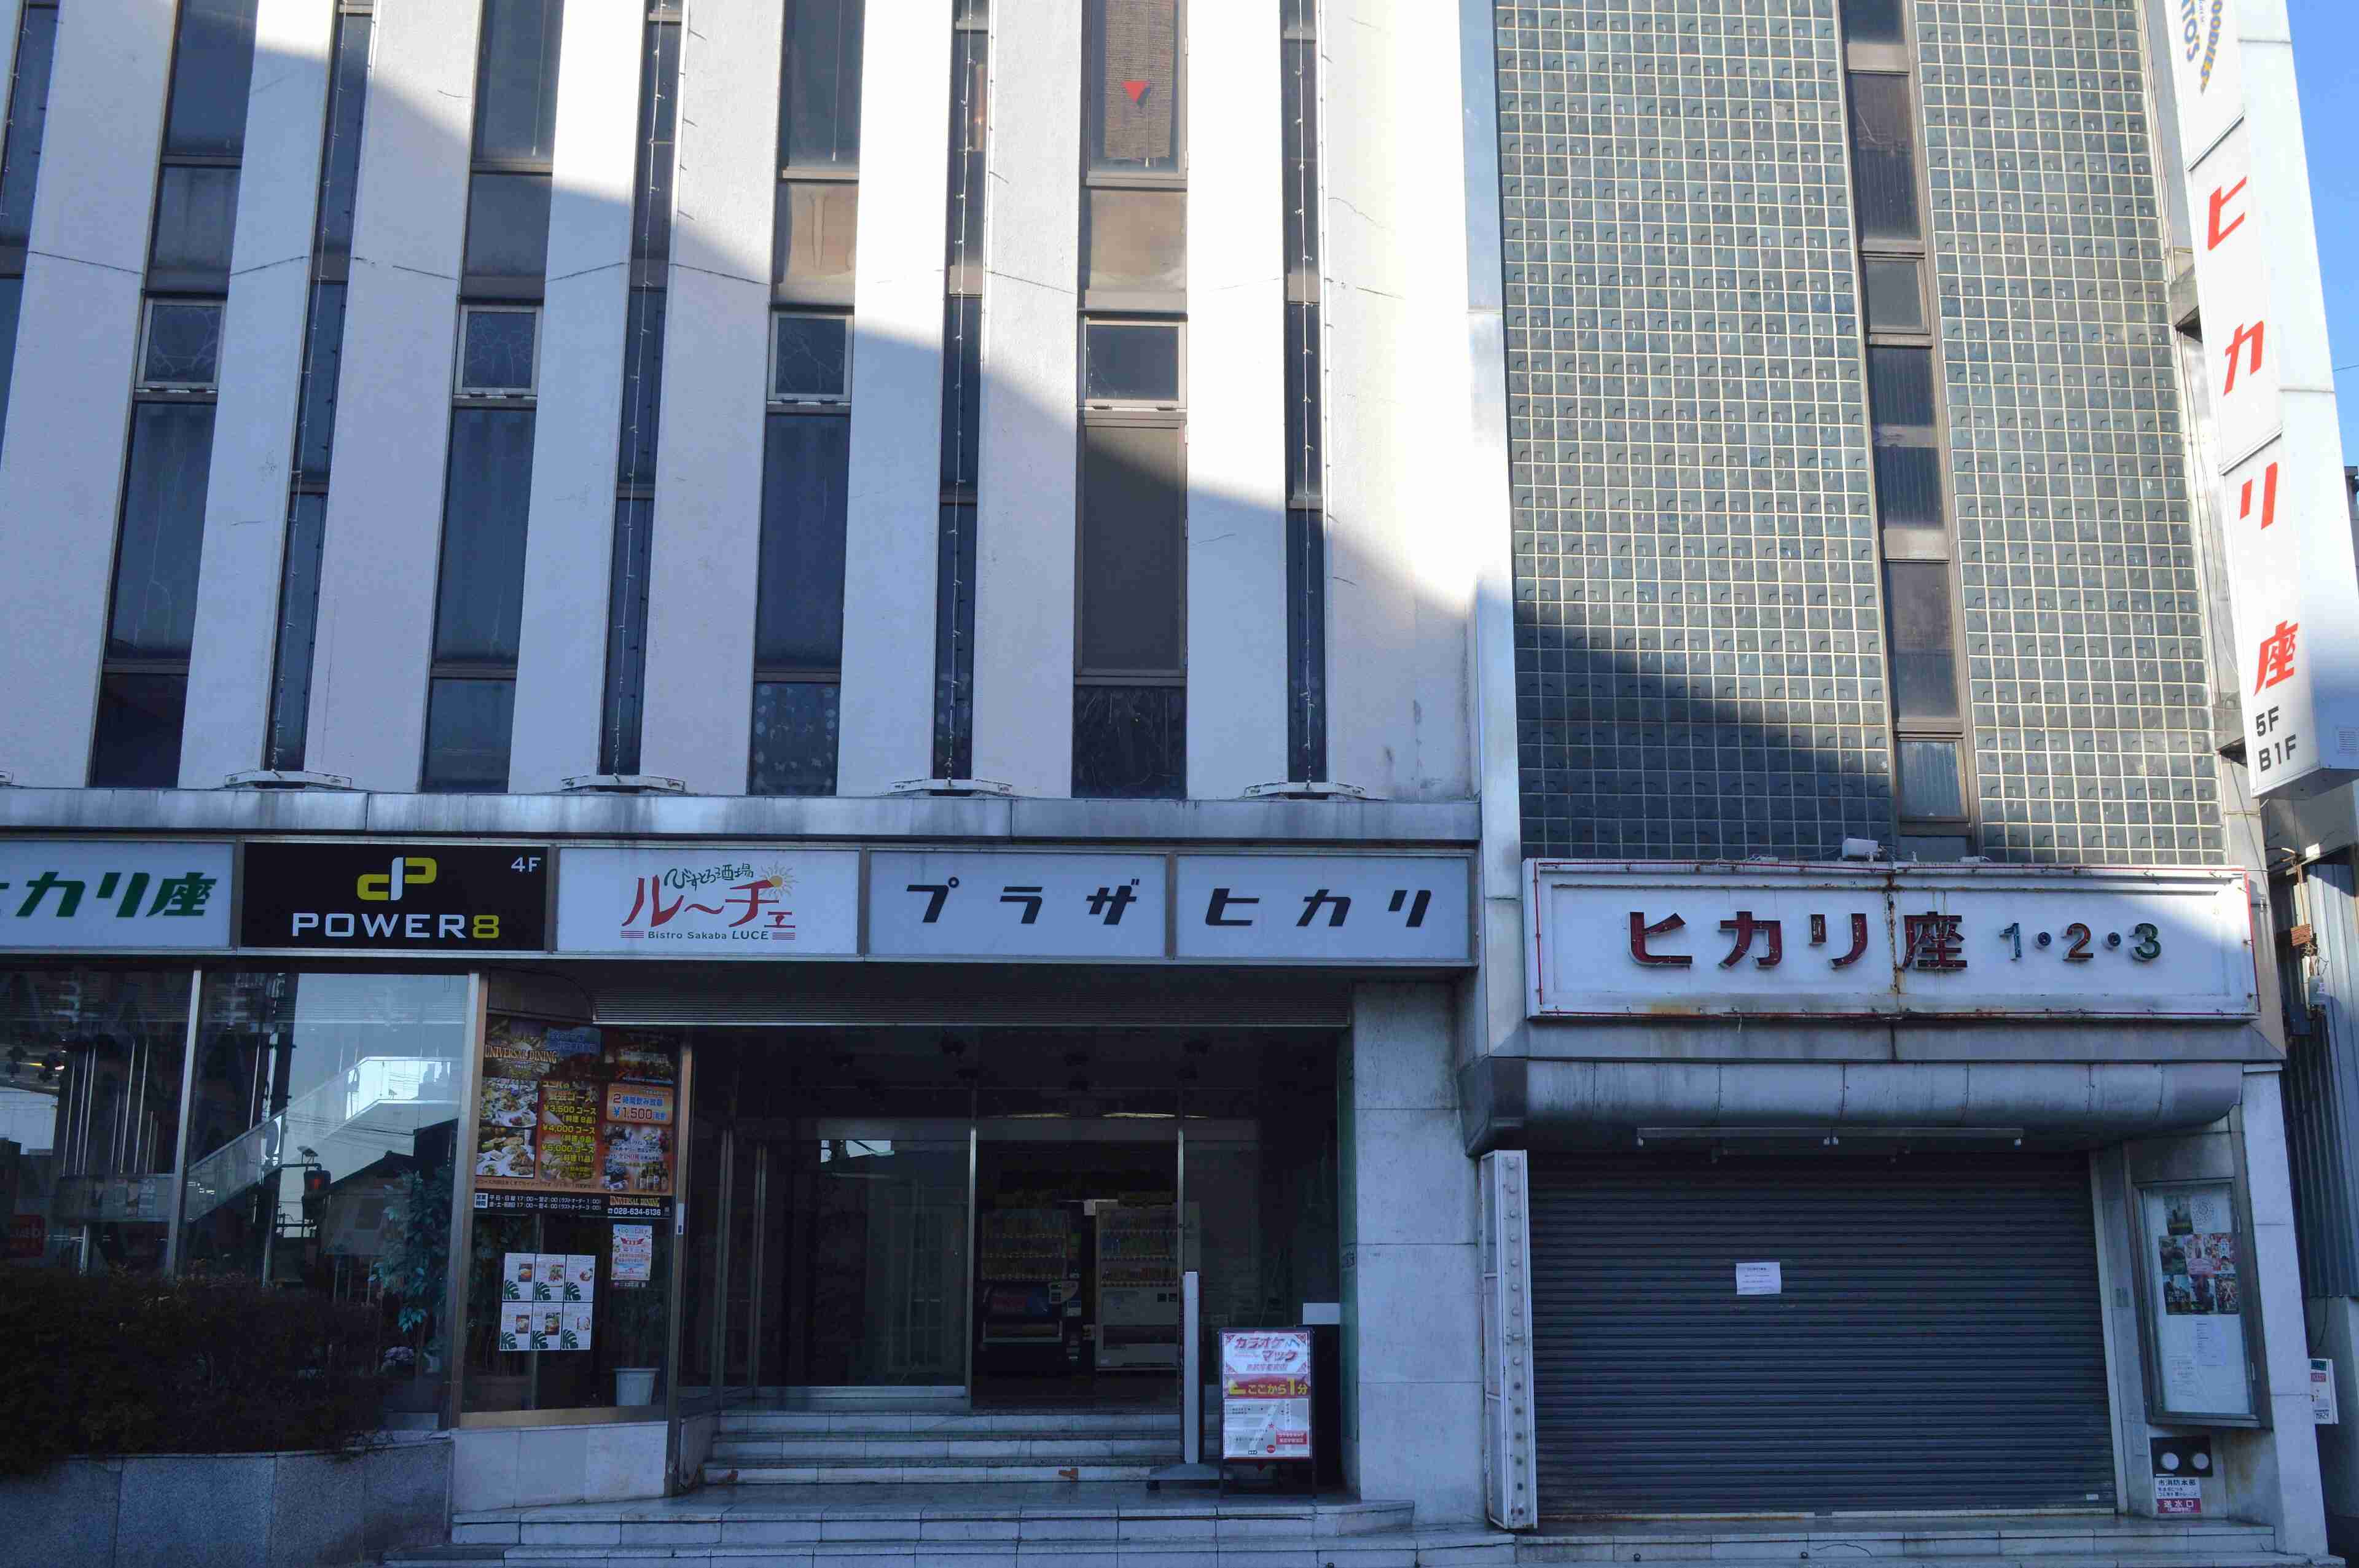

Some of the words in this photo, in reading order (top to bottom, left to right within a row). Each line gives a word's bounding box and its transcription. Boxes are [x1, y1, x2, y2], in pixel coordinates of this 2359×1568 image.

[2208, 175, 2298, 696] ヒカリ座
[2256, 705, 2280, 738] 5F
[2259, 733, 2298, 772] B1F
[511, 857, 541, 873] 4F
[0, 872, 217, 918] カリ座
[907, 876, 1140, 926] プラザ
[1205, 887, 1432, 928] ヒカリ
[292, 913, 499, 939] POWER8
[687, 931, 727, 940] Sakaba
[732, 930, 769, 940] LUCE
[1628, 910, 1968, 970] ヒカリ座
[485, 1045, 529, 1060] UNIVERSAL
[530, 1050, 557, 1063] DINING
